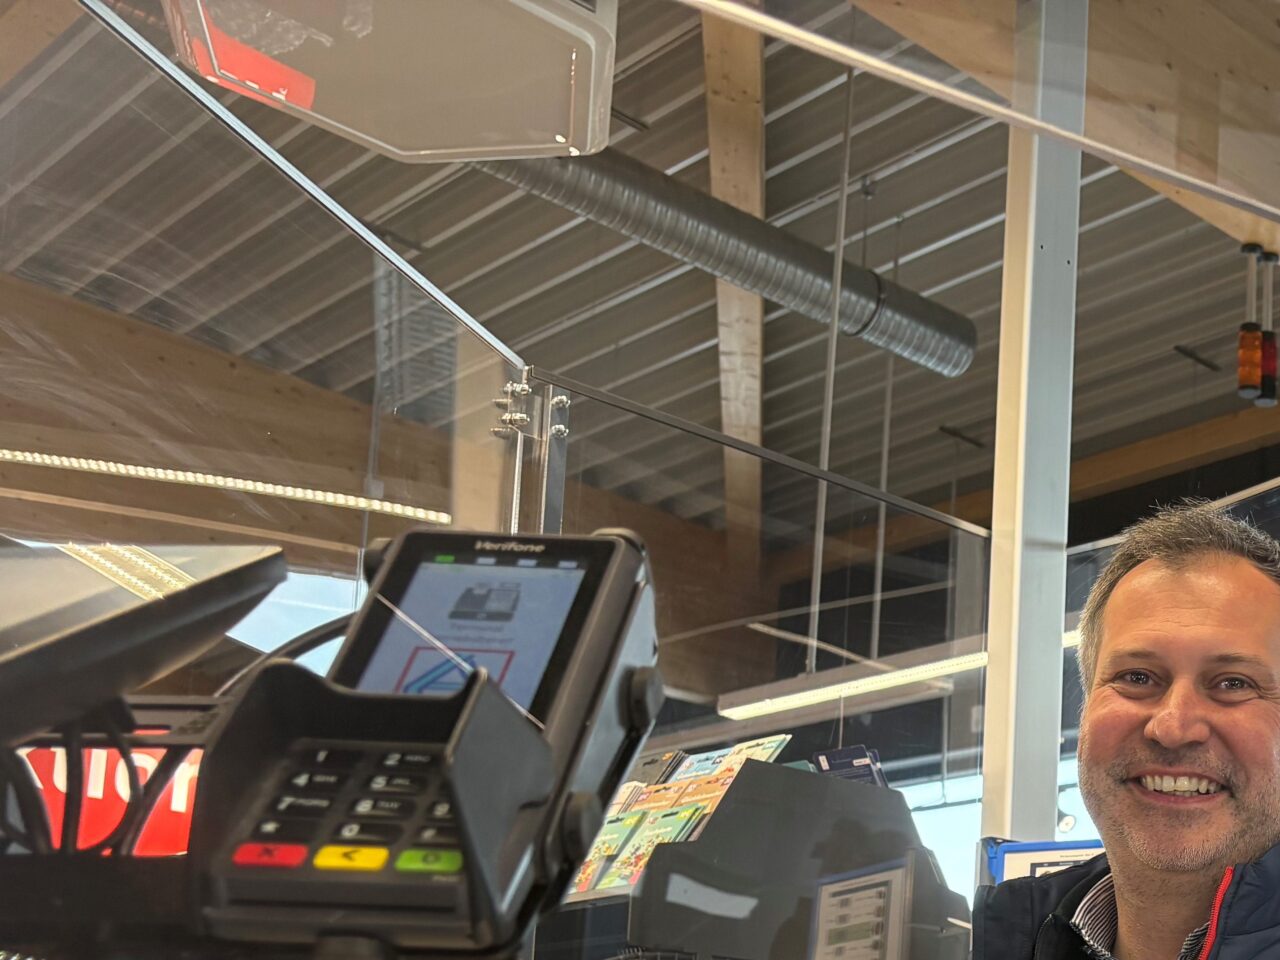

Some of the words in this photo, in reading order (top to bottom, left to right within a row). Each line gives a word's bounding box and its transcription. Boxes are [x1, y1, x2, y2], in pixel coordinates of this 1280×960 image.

[474, 539, 546, 553] Verifone
[316, 750, 329, 763] 1
[383, 752, 402, 766] 2
[291, 773, 310, 787] 4
[370, 775, 389, 790] 5
[276, 797, 294, 811] 7
[354, 799, 374, 814] 8
[340, 824, 361, 838] 0
